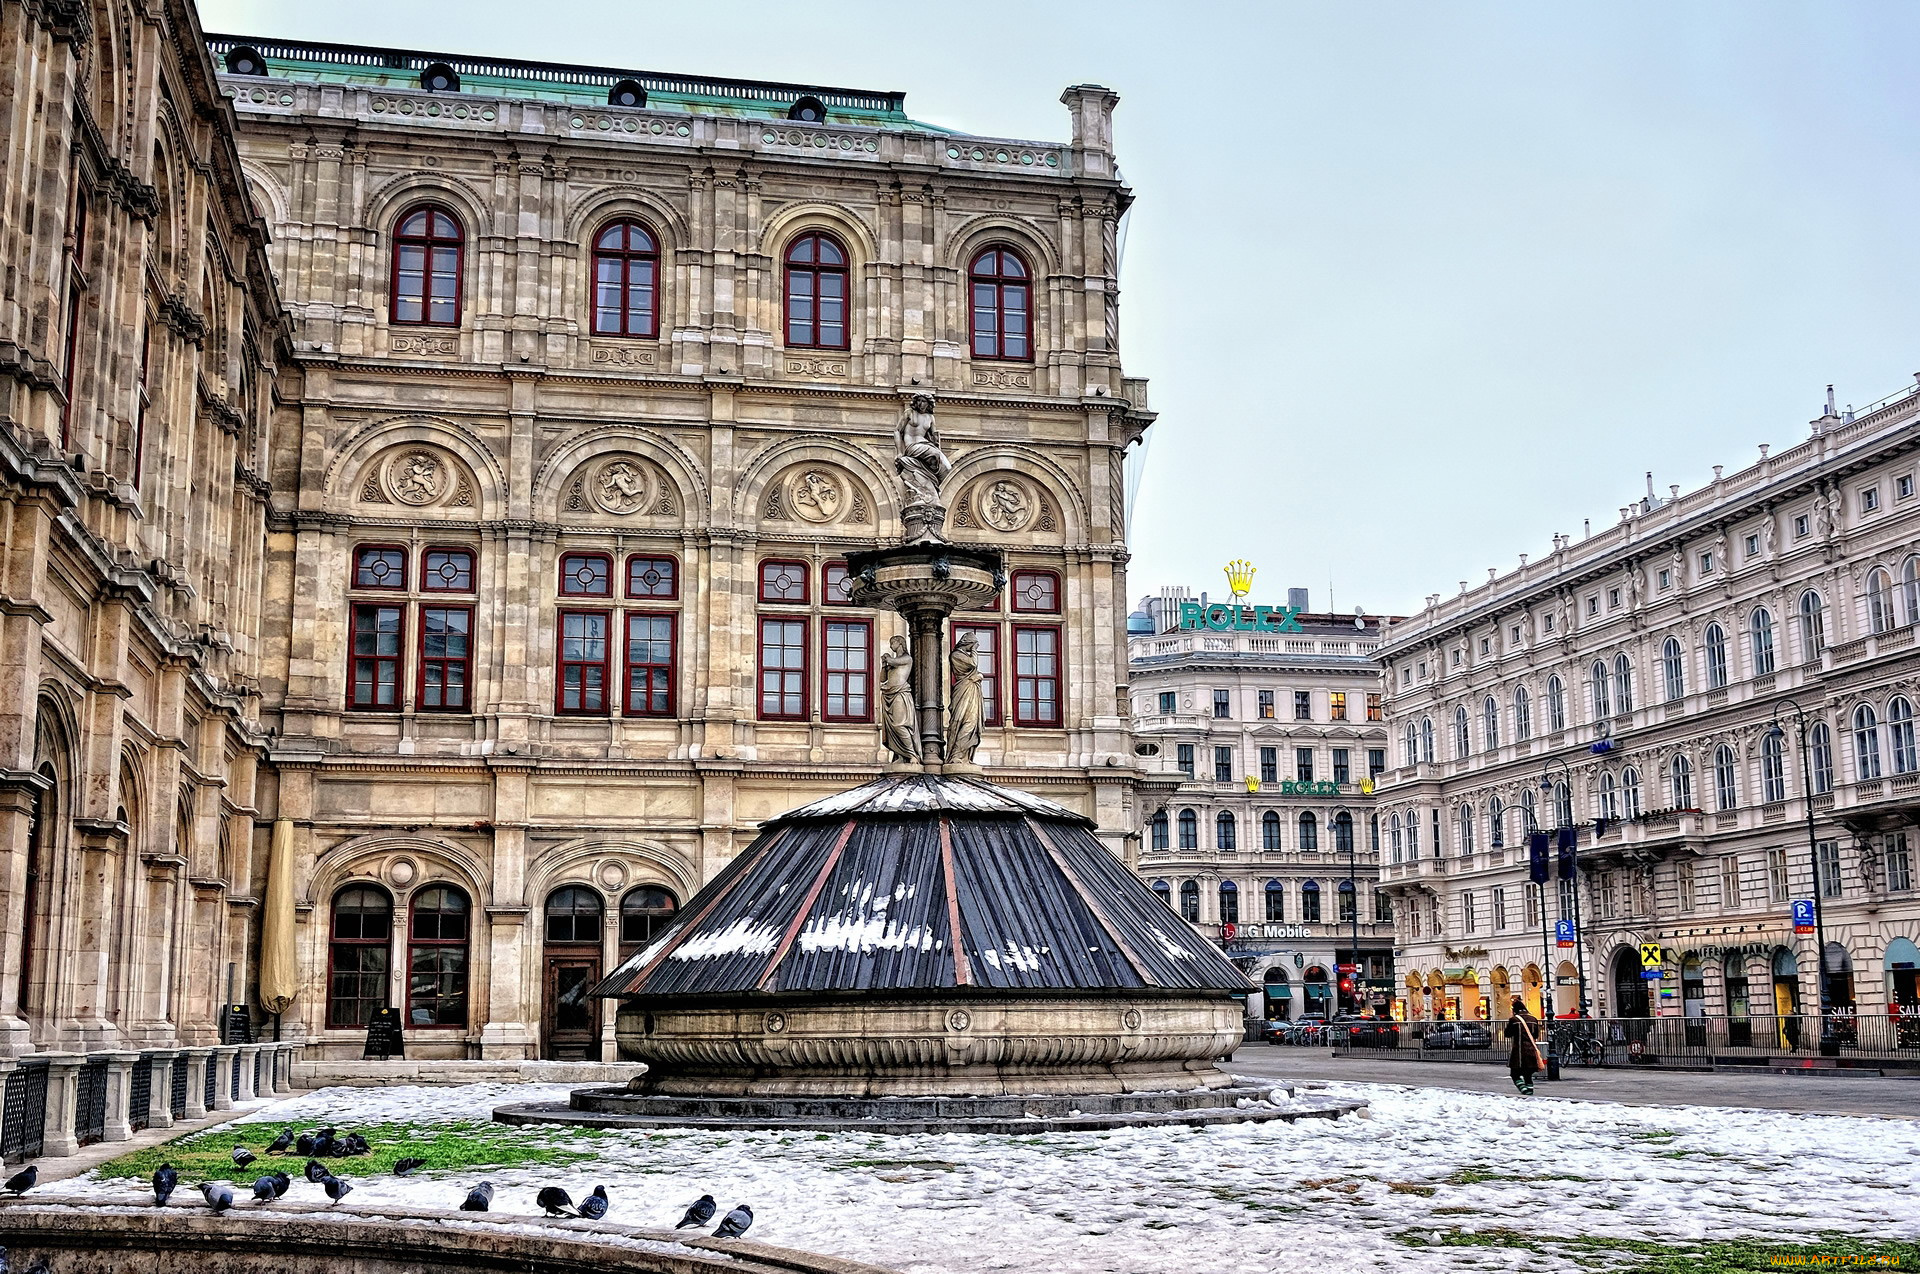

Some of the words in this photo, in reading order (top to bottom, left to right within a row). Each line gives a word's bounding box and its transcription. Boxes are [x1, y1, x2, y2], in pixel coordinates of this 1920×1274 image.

[1180, 603, 1302, 632] ROLEX
[1281, 780, 1341, 795] ROLEX
[1239, 925, 1259, 938] LG
[1263, 925, 1312, 938] Mobile
[1831, 1006, 1855, 1019] SALE
